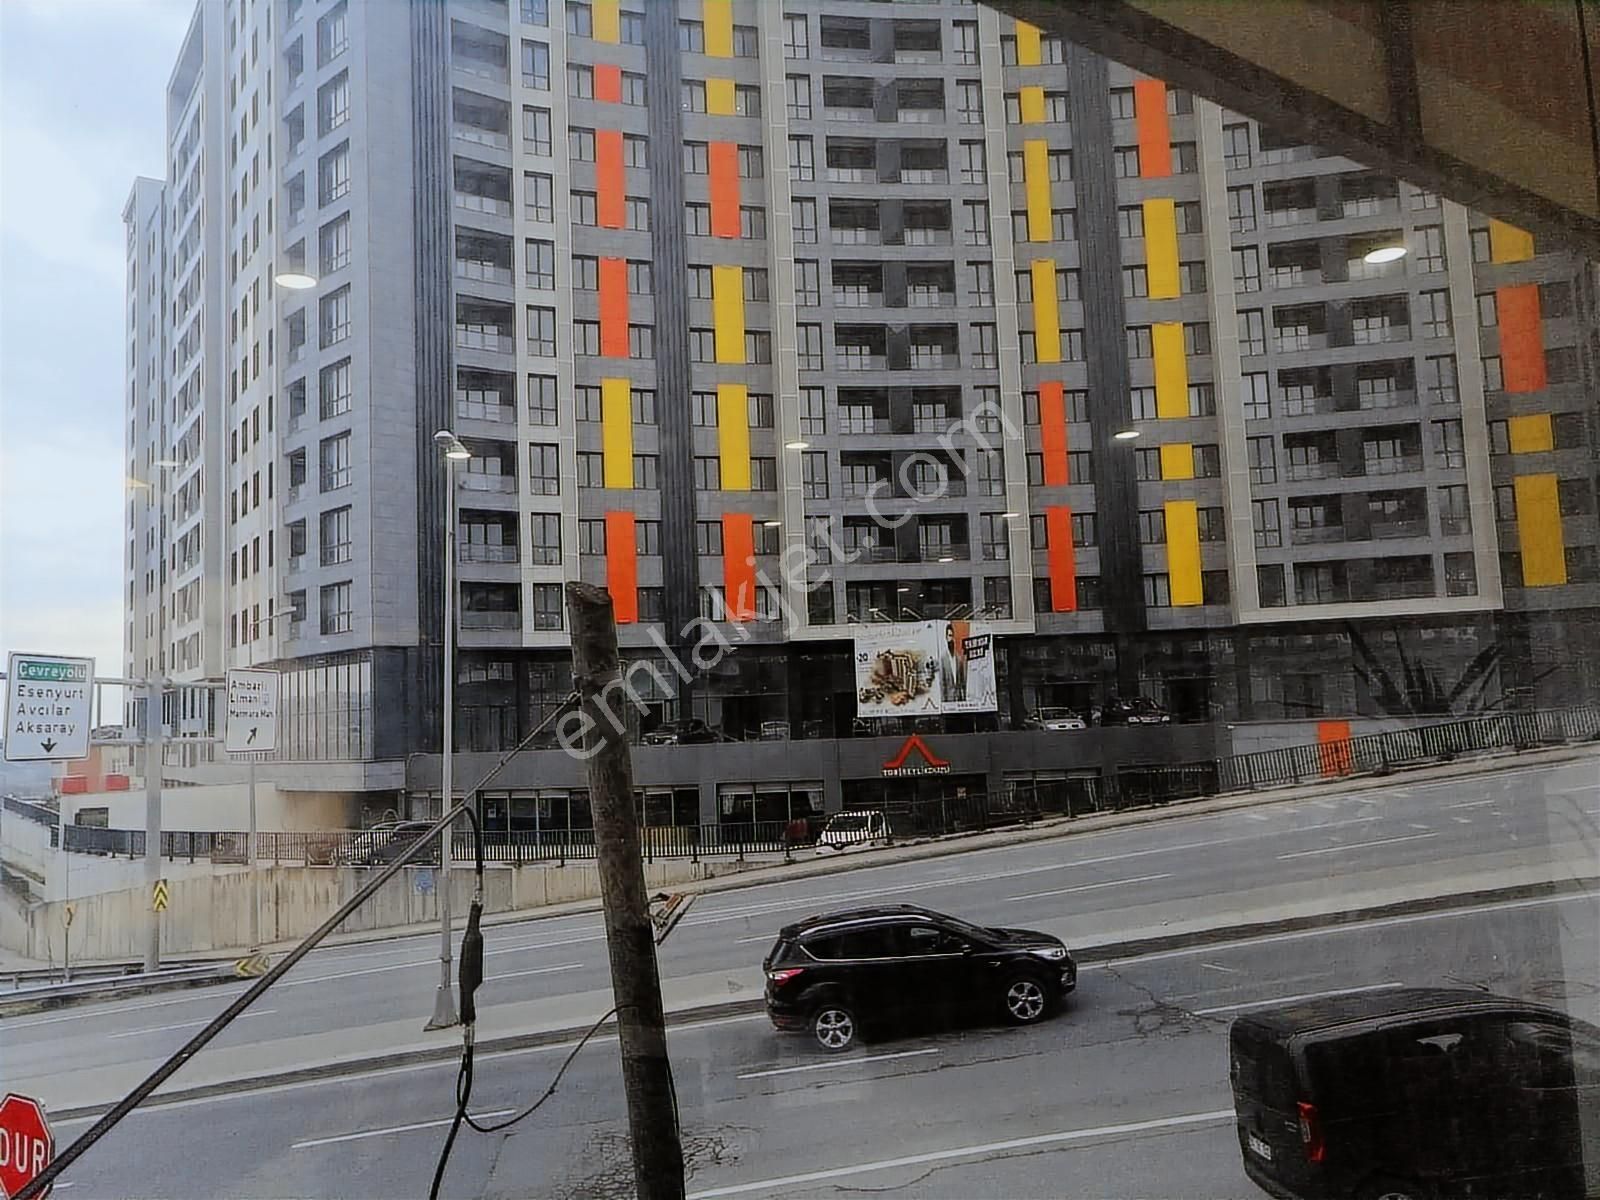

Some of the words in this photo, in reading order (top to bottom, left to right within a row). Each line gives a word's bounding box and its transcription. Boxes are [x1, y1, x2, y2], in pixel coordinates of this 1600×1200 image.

[19, 662, 86, 680] Çevreyolu
[18, 684, 83, 701] Esenyurt
[17, 702, 71, 716] Avcılar
[16, 721, 76, 736] Aksaray
